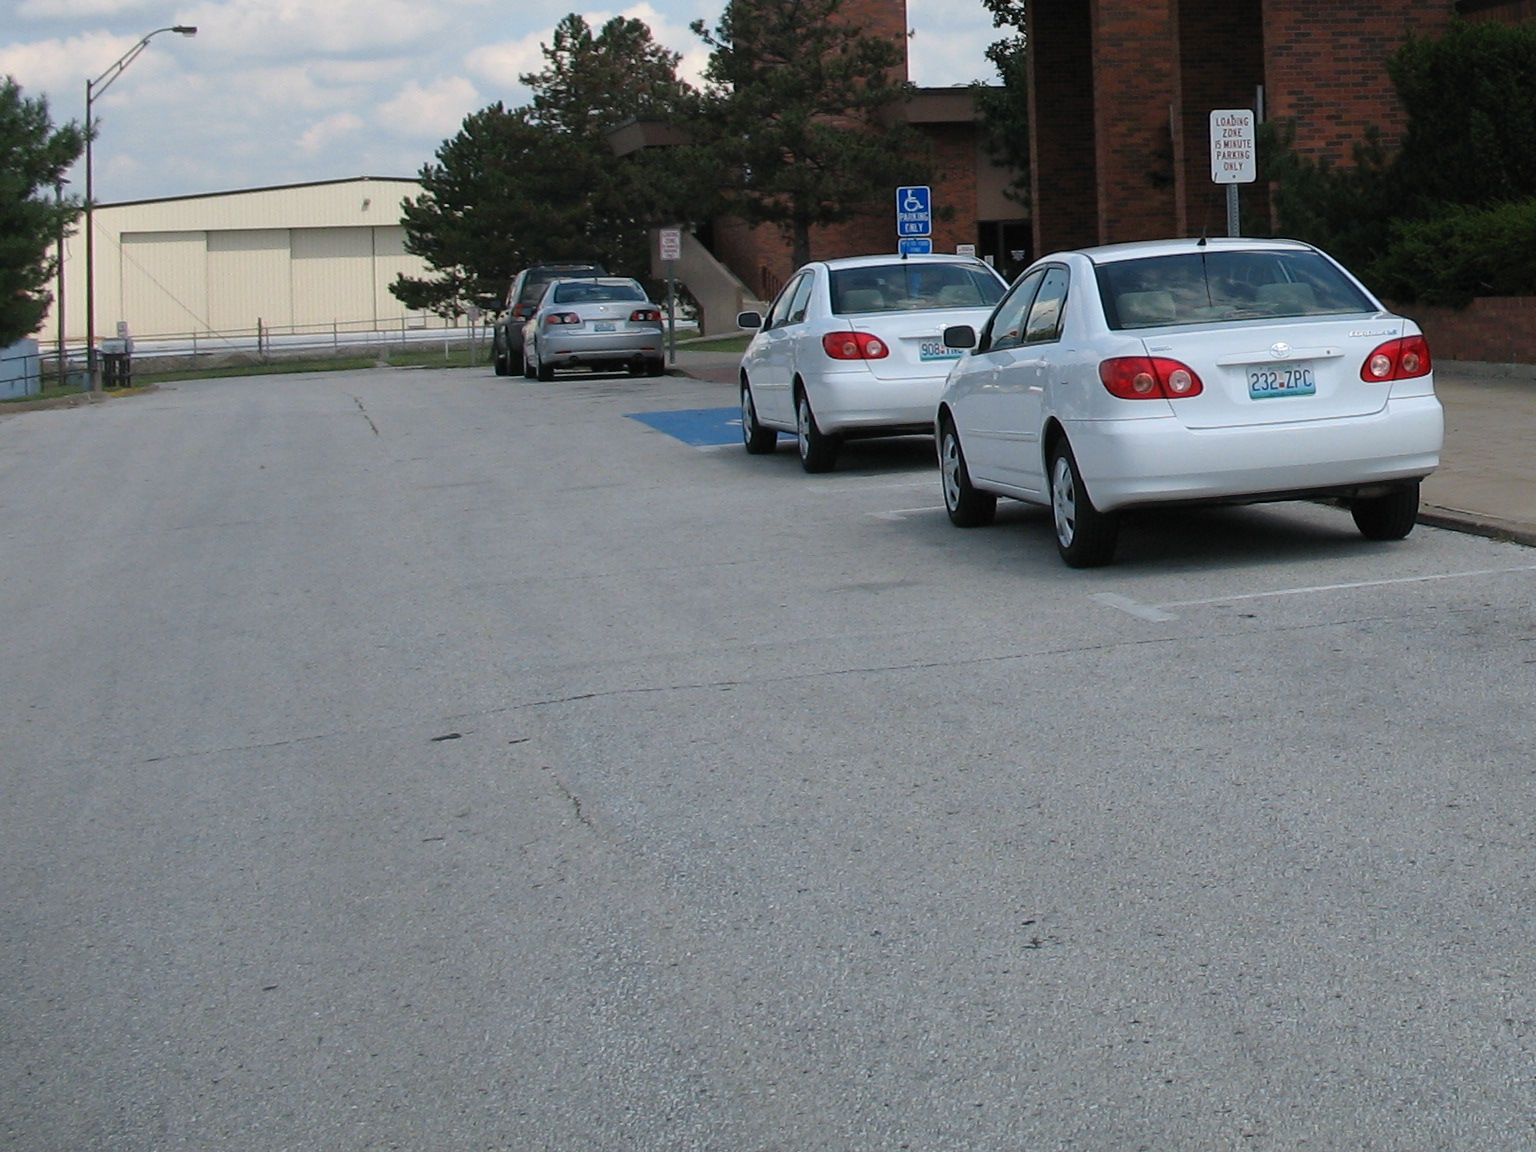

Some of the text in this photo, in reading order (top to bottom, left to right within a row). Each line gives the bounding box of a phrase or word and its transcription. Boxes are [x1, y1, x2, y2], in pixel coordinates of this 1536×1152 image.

[1216, 117, 1249, 127] LOADING
[1222, 128, 1243, 138] ZONE
[1215, 139, 1252, 150] 15 MINUTE
[1216, 150, 1251, 160] PARKING
[1223, 161, 1244, 171] ONLY
[900, 211, 929, 222] PARKING
[905, 222, 924, 233] ONLY
[921, 343, 940, 356] 908
[1250, 369, 1313, 392] 232 ZPC
